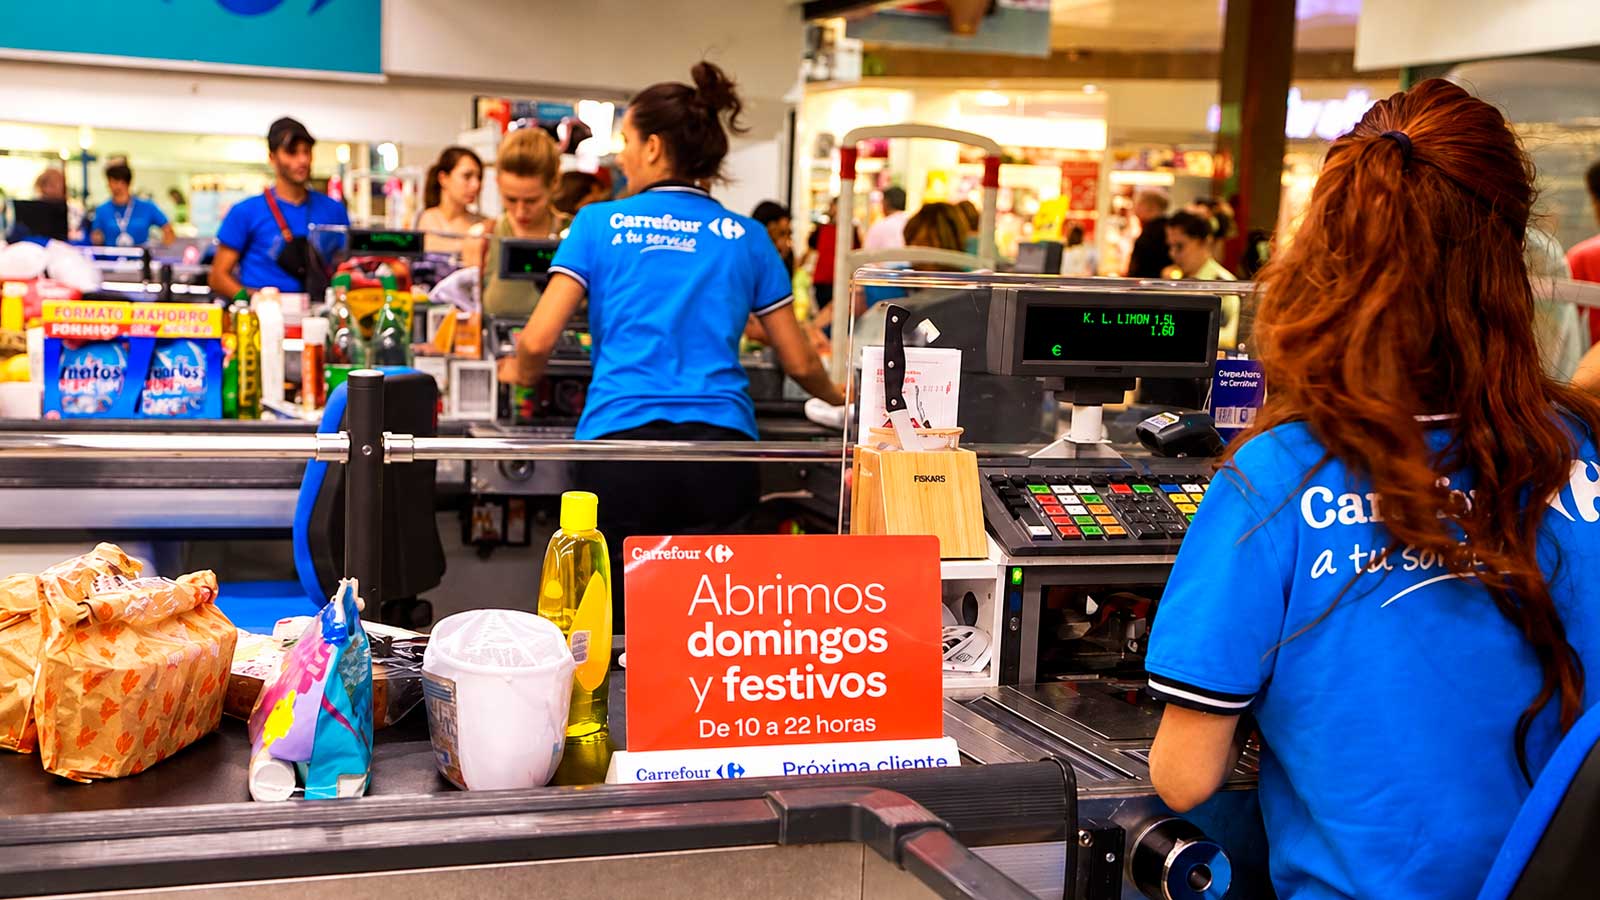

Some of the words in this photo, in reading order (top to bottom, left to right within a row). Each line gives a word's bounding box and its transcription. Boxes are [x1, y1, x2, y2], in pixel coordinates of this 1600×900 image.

[609, 212, 702, 233] Carrefour
[611, 233, 623, 245] a
[625, 229, 643, 243] tu
[54, 306, 123, 320] FORMATO
[1083, 312, 1095, 323] K.
[1101, 313, 1113, 324] L.
[1117, 313, 1150, 325] LIMON
[1154, 314, 1175, 326] 1.5L
[1151, 326, 1175, 336] 1.60
[914, 474, 946, 483] FISKARS
[631, 546, 702, 561] Carrefour
[1310, 549, 1337, 579] a
[1349, 543, 1393, 575] tu
[687, 573, 887, 616] Abrimos
[687, 618, 889, 664] domingos
[687, 675, 714, 713] y
[722, 663, 888, 702] festivos
[699, 719, 730, 738] De
[734, 717, 760, 737] 10
[765, 721, 779, 736] a
[784, 716, 811, 735] 22
[816, 714, 876, 734] horas
[636, 766, 711, 782] Carrefour
[782, 759, 870, 777] Próxima
[876, 755, 948, 772] cliente
